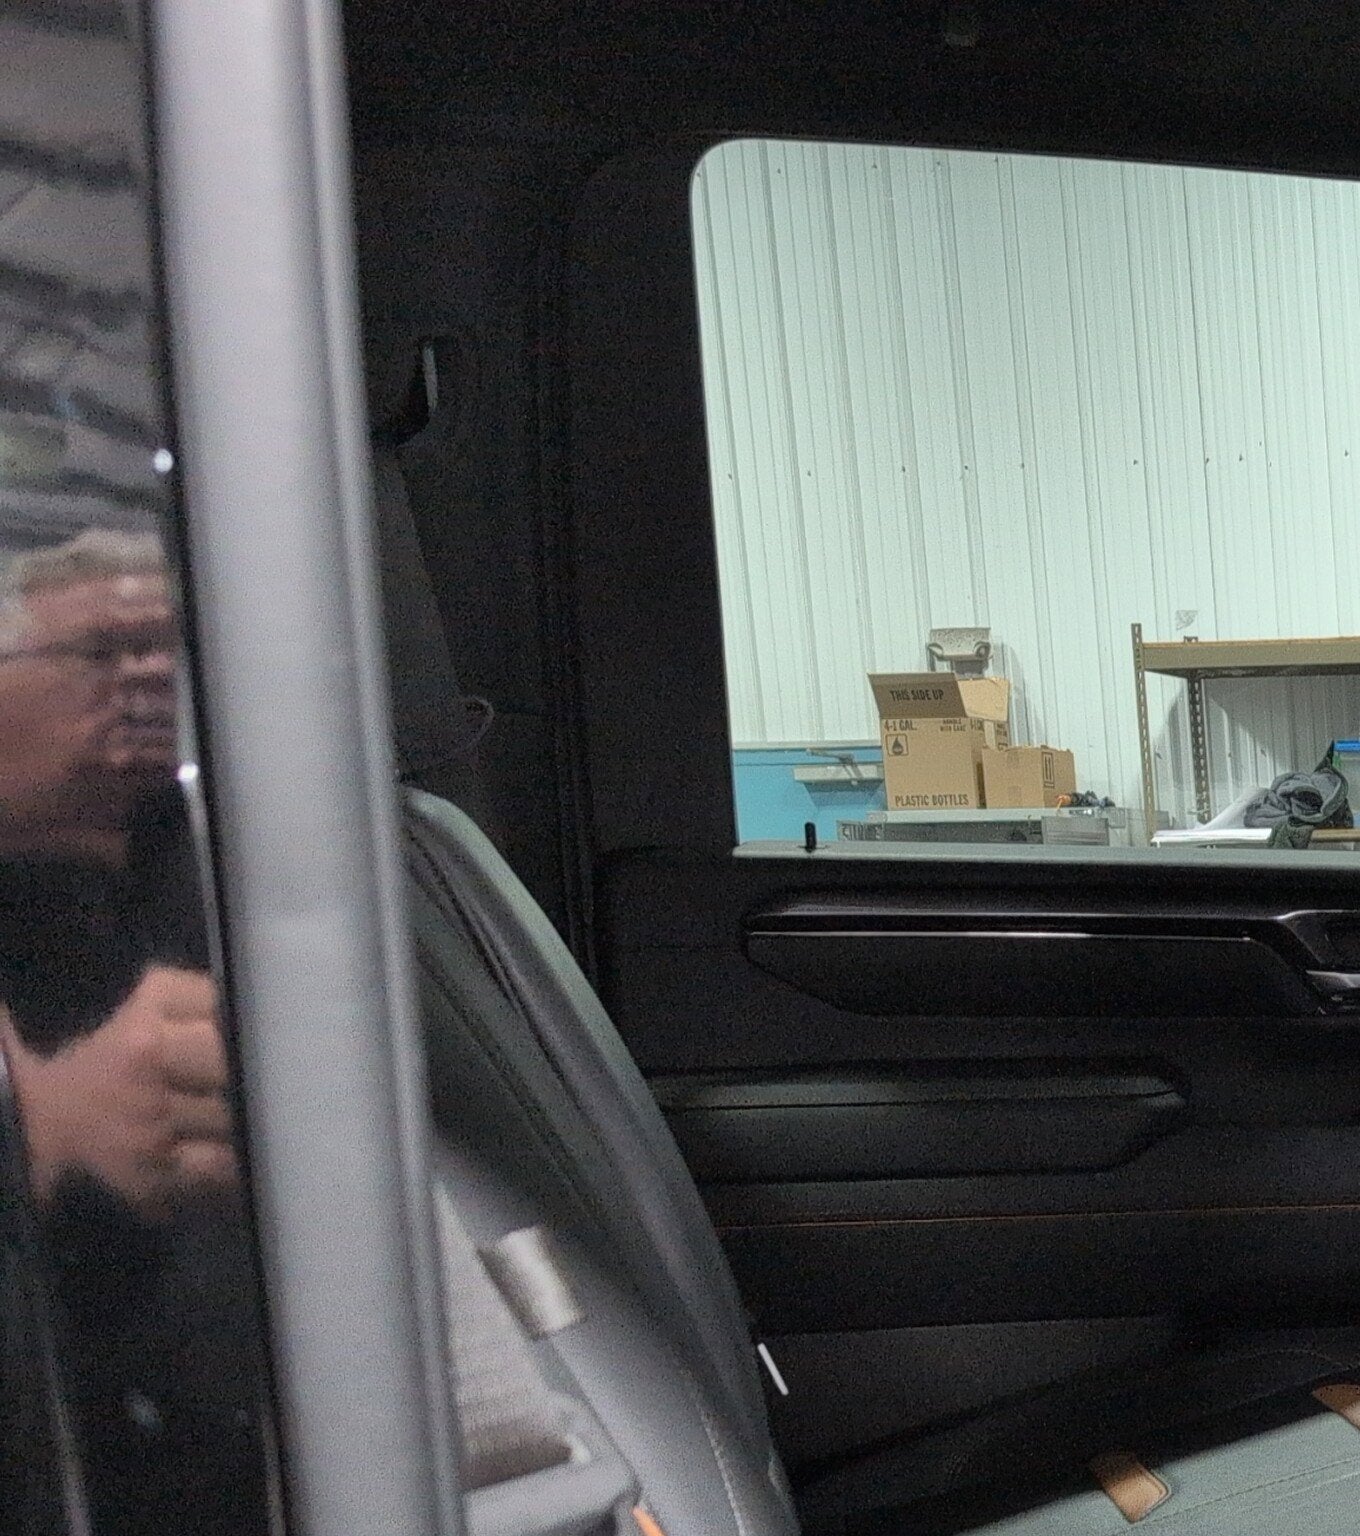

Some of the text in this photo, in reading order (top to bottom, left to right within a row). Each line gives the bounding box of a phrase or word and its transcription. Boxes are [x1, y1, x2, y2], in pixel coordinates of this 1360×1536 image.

[889, 688, 944, 702] THIS SIDE UP
[894, 793, 970, 808] PLASTIC BOTTLES
